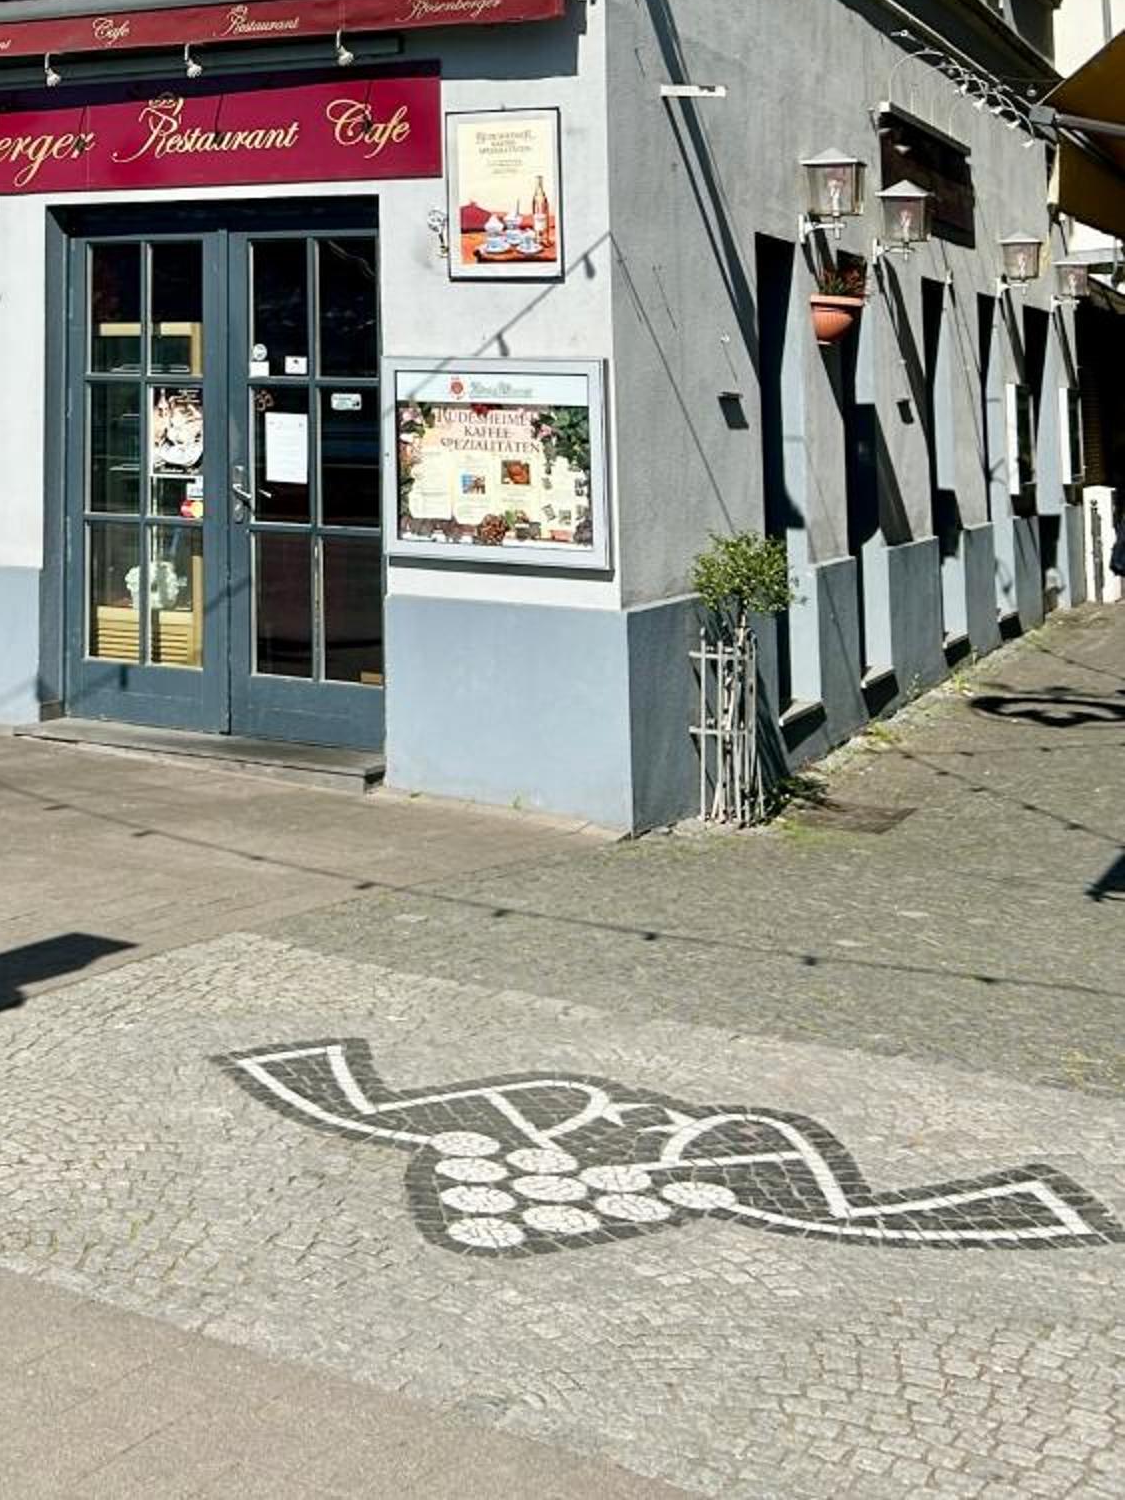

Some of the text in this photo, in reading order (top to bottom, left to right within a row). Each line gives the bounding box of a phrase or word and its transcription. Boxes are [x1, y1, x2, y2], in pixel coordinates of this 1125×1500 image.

[92, 17, 131, 45] Cafe
[213, 5, 300, 36] Restaurant
[111, 98, 300, 163] Restaurant
[326, 99, 412, 159] Cafe
